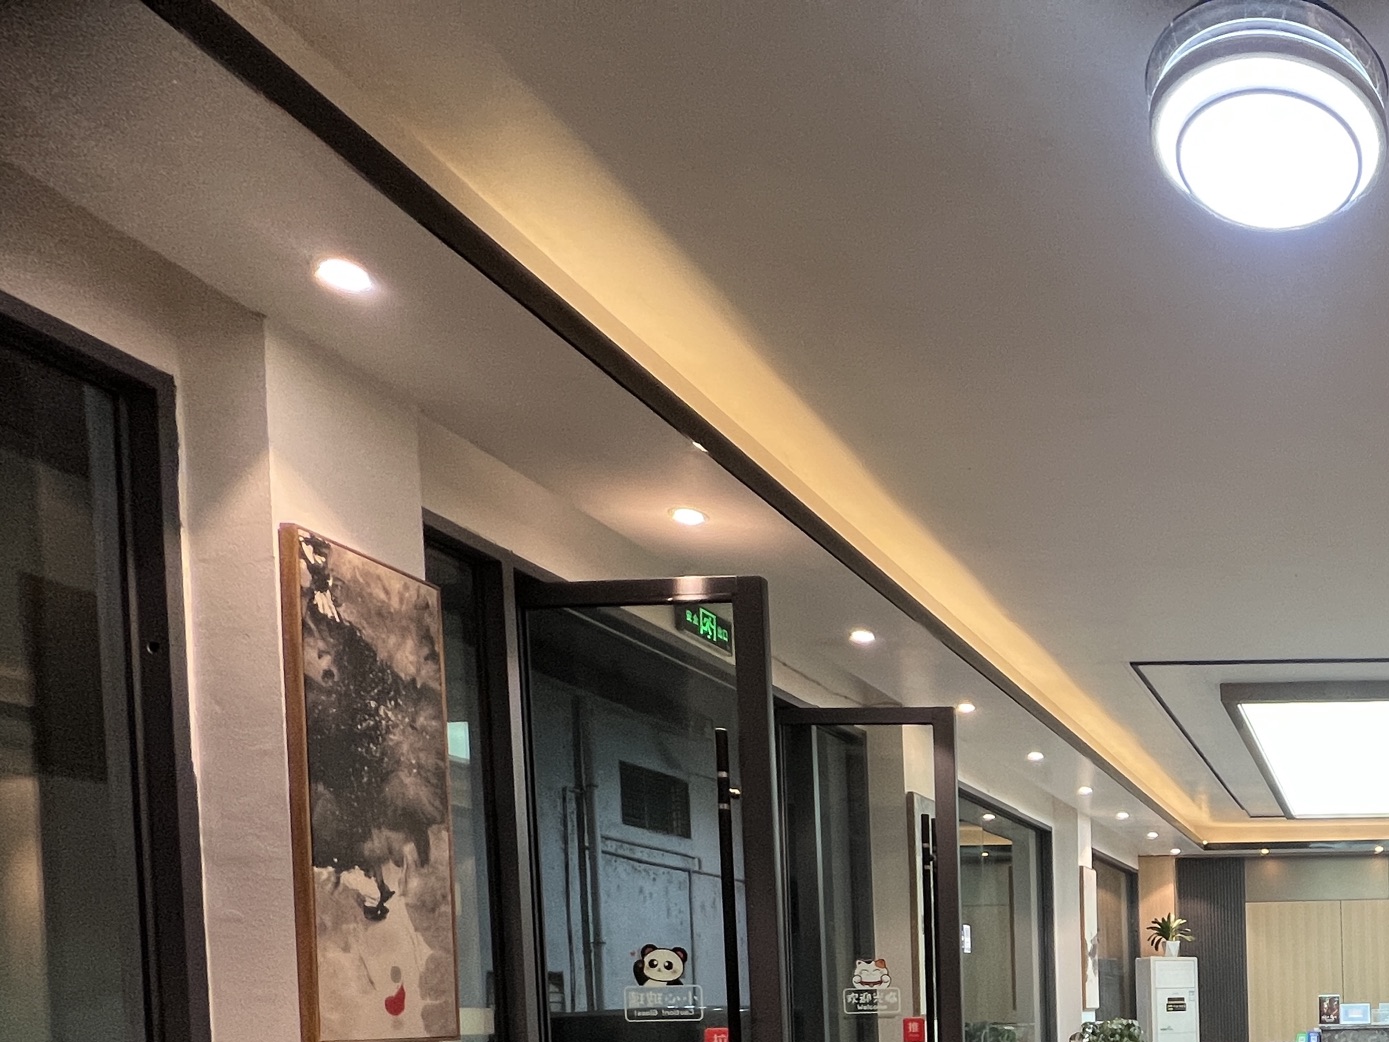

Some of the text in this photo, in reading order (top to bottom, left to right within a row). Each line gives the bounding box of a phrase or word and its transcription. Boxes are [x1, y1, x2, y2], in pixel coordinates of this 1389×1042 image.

[847, 992, 898, 1004] 欢迎光临
[908, 1022, 919, 1033] 推
